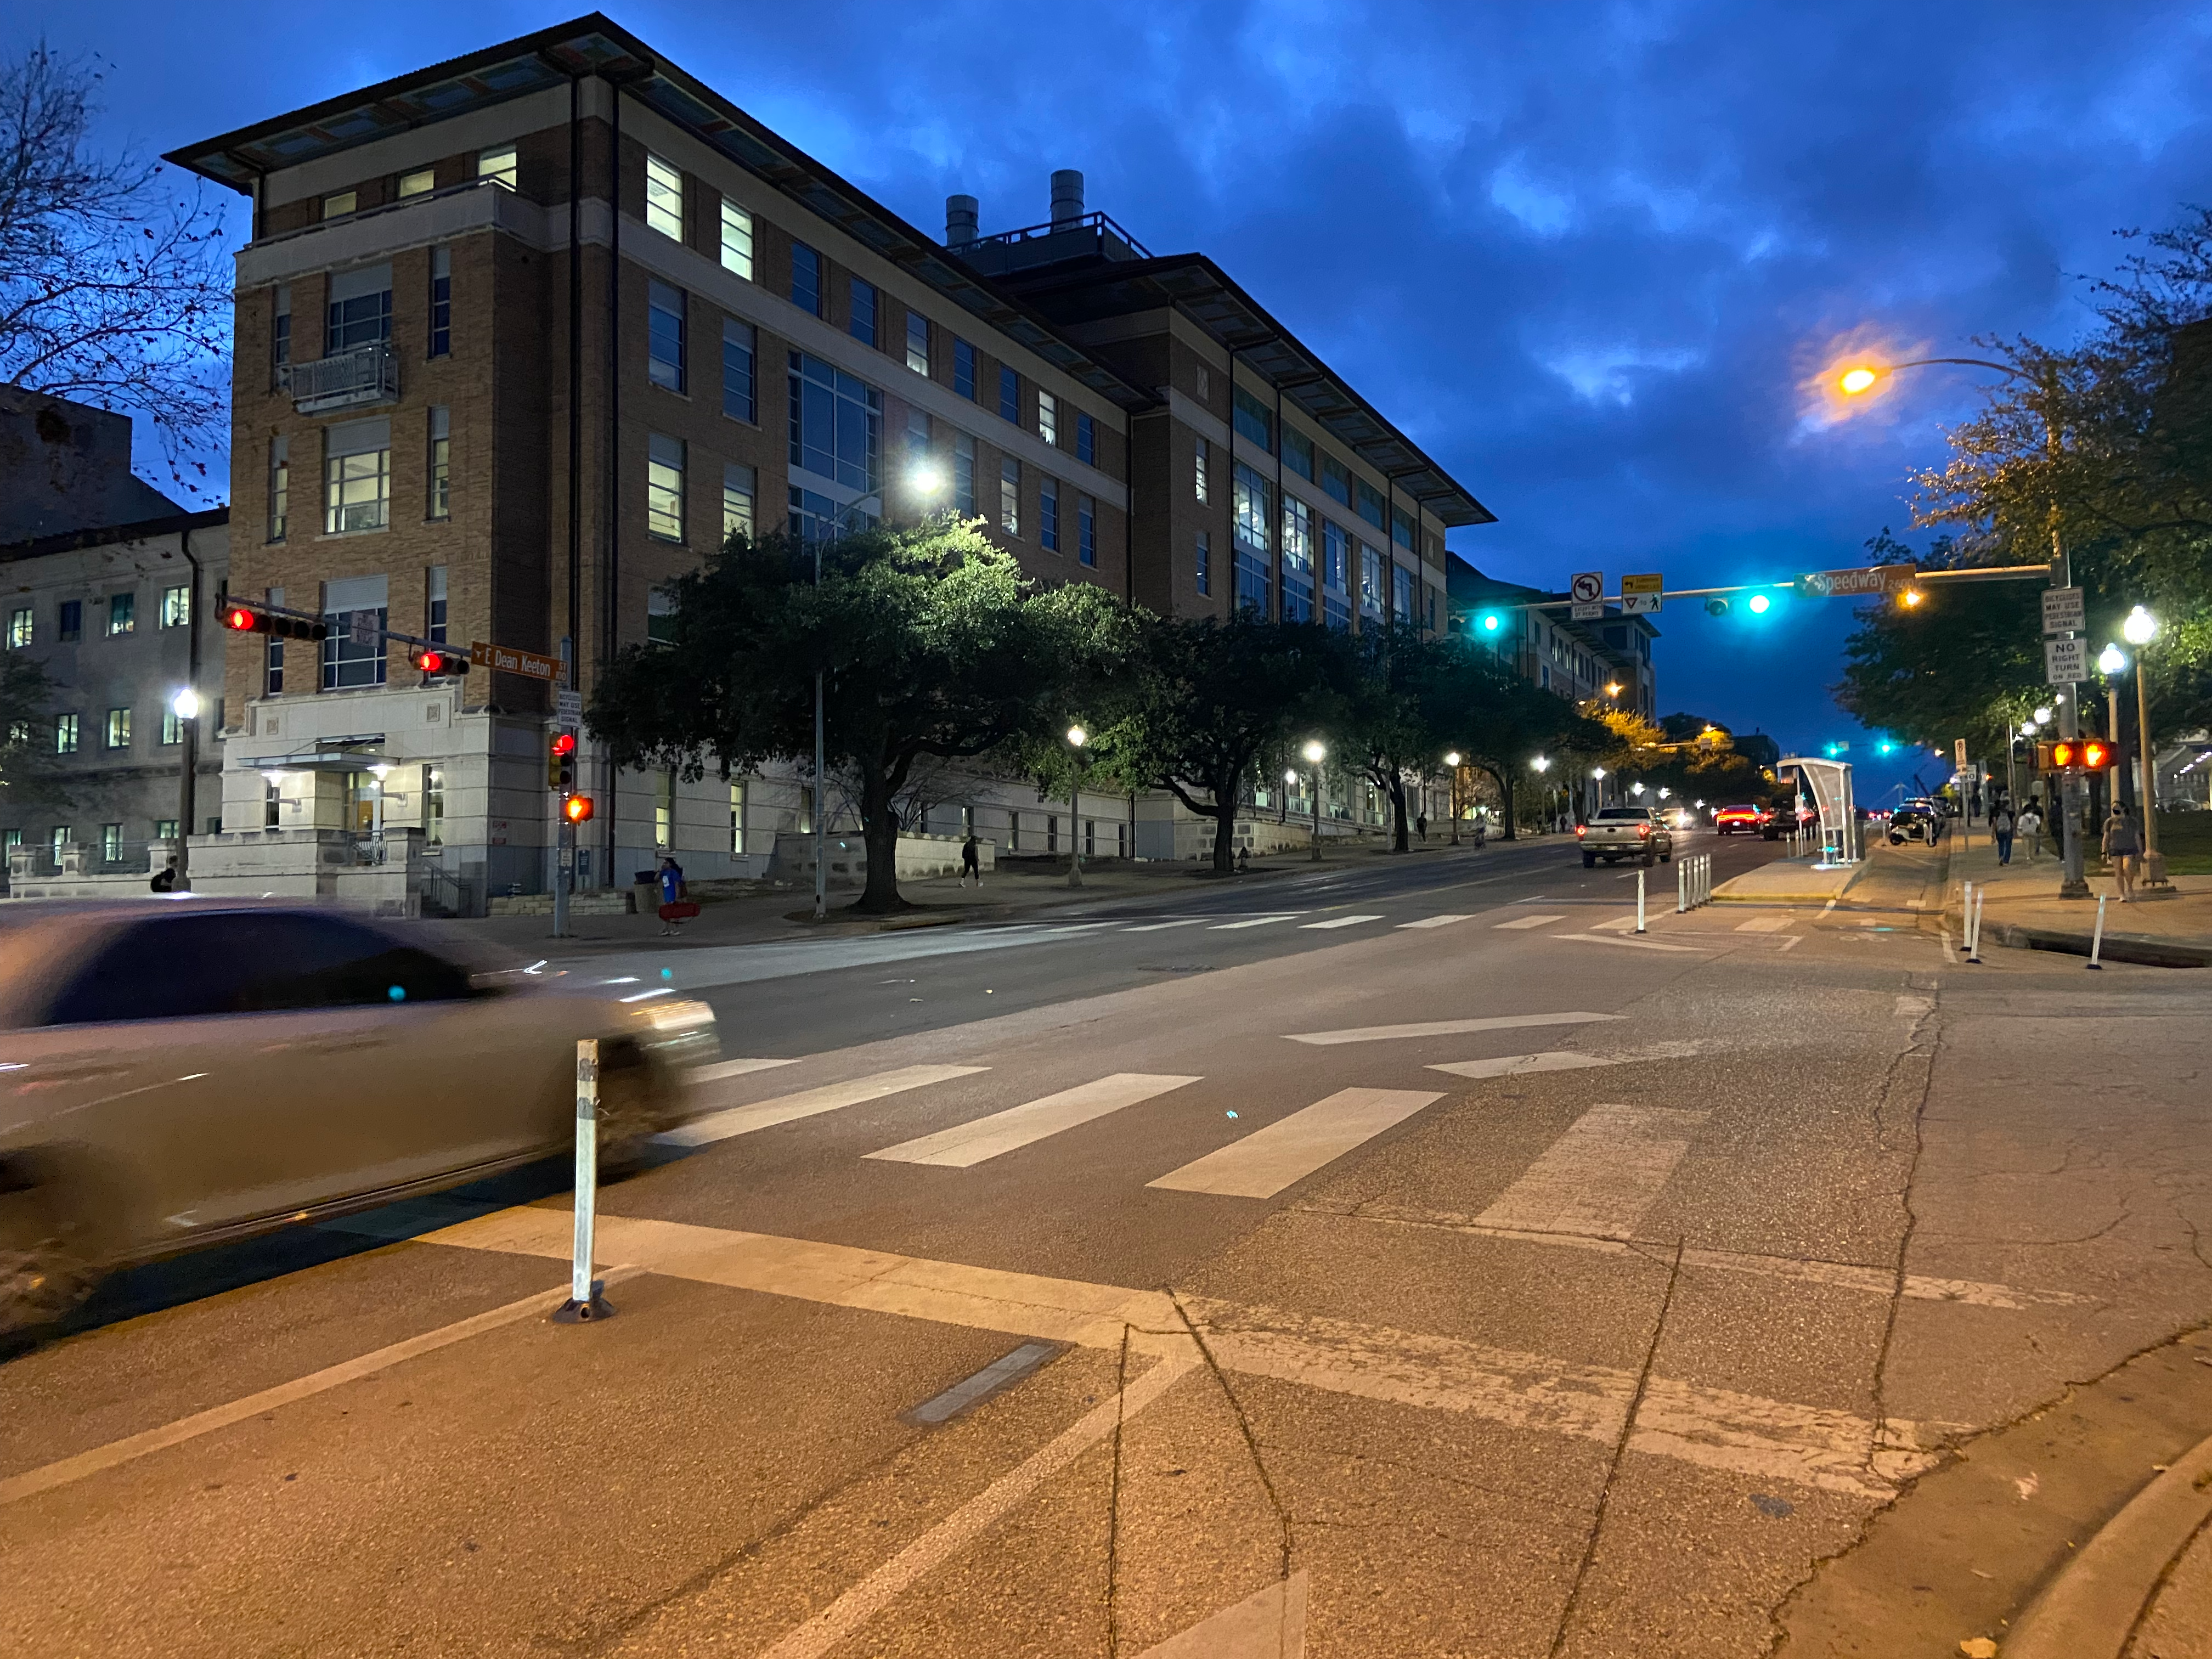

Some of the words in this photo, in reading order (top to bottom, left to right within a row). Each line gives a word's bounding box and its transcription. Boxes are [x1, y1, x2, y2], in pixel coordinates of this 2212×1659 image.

[1818, 572, 1886, 596] Speedway
[2049, 620, 2078, 628] SIGNAL
[2056, 643, 2075, 653] NO
[485, 647, 492, 665] E
[495, 650, 518, 670] Dean
[522, 655, 551, 677] Keeton
[2052, 653, 2080, 663] RIGHT
[558, 662, 567, 671] ST
[555, 671, 566, 680] 100
